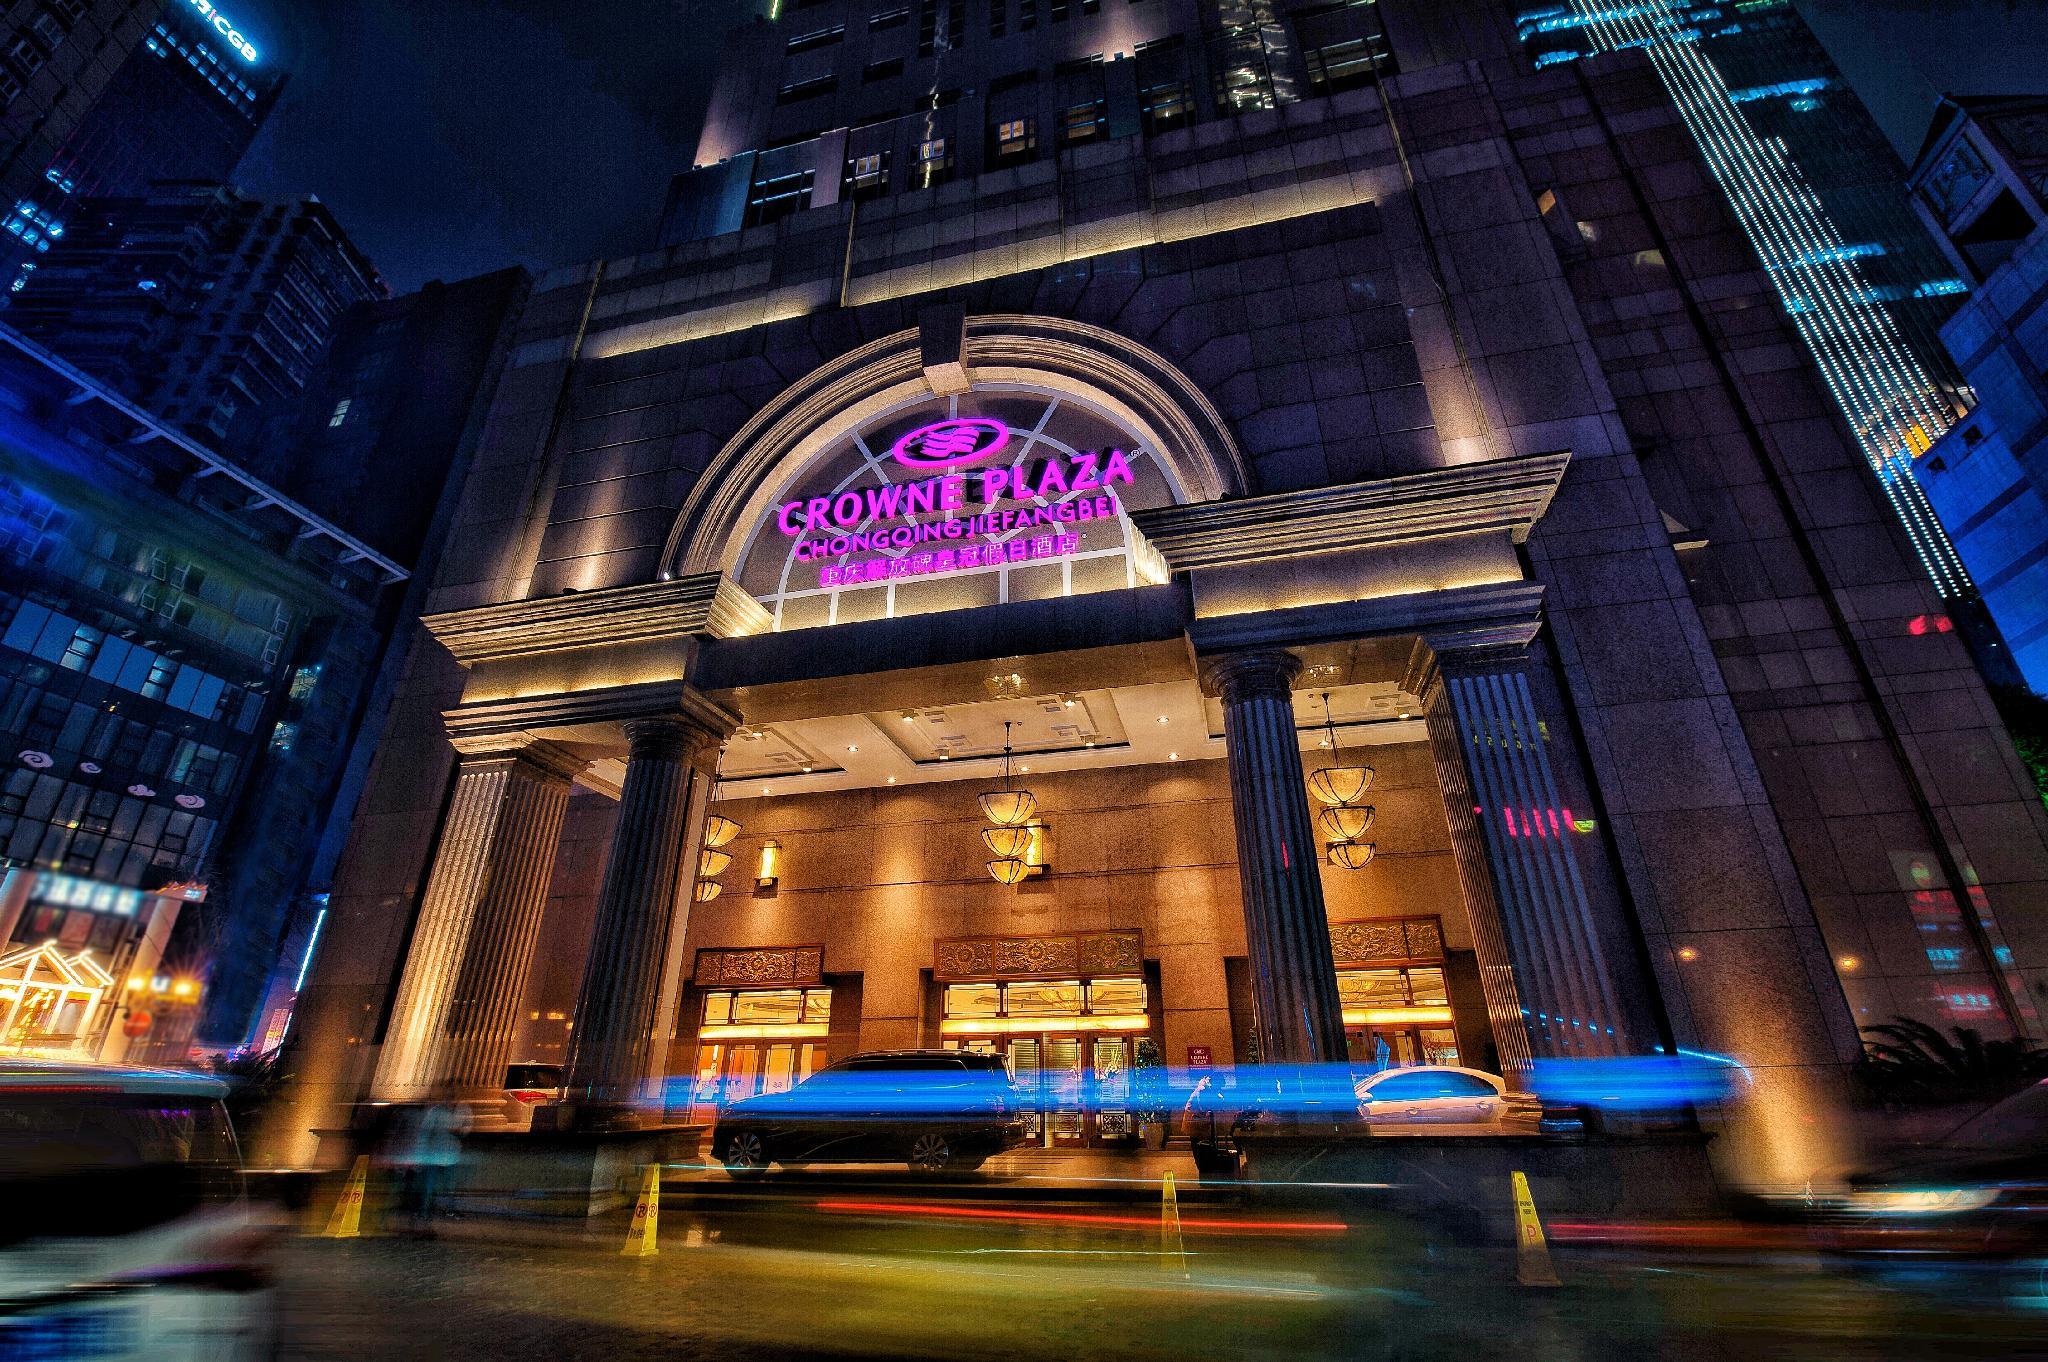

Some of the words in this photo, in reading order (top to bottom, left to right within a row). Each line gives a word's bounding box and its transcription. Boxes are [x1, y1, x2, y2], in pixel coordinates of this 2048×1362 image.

[213, 16, 257, 62] CGB
[778, 474, 965, 537] CROWNE
[982, 448, 1136, 505] PLAZA
[795, 517, 963, 563] CHONGQING
[964, 495, 1118, 541] JIEFANGBEI
